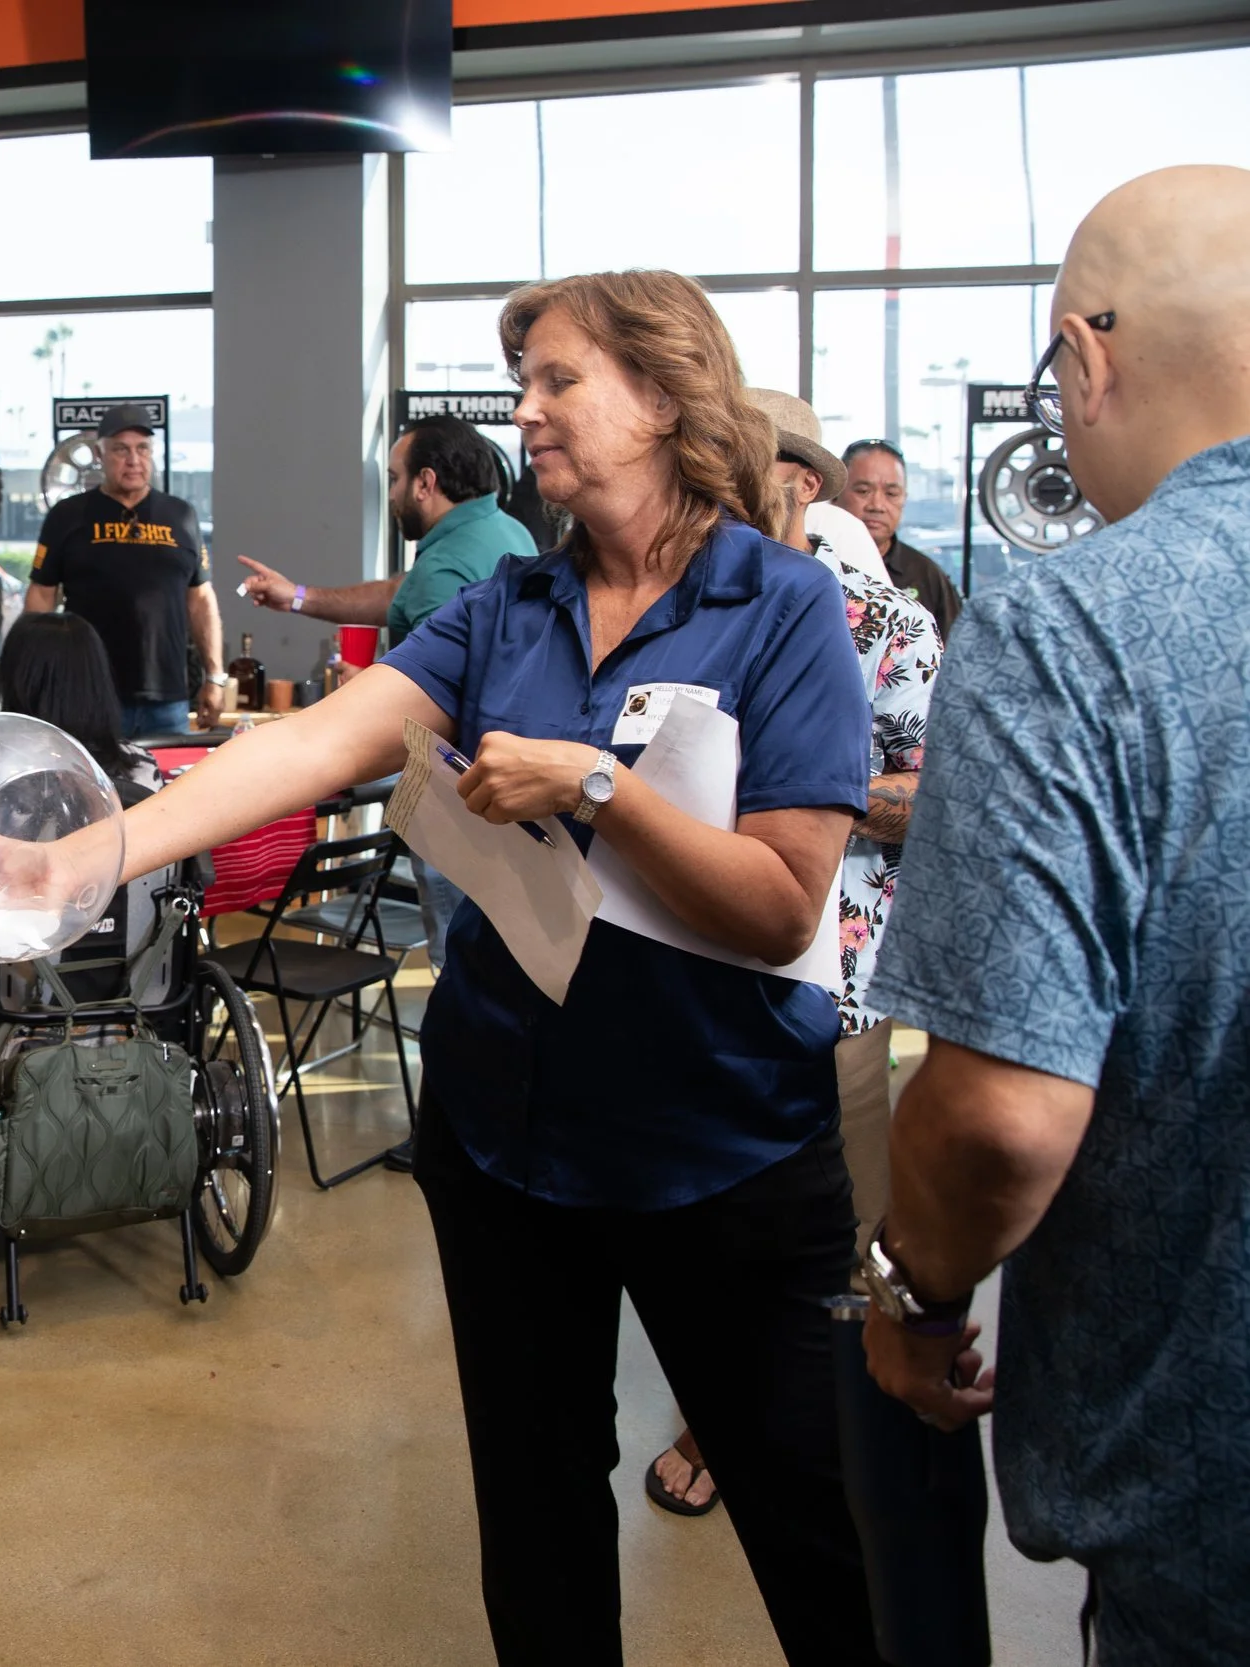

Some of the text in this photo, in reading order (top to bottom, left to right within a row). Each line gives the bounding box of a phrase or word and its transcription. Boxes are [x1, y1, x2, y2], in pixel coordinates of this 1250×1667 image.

[409, 397, 515, 412] METHOD
[62, 405, 158, 421] RACE
[982, 408, 1028, 417] RACE
[94, 522, 100, 539] I
[105, 522, 131, 539] FIX
[685, 688, 704, 696] NAME
